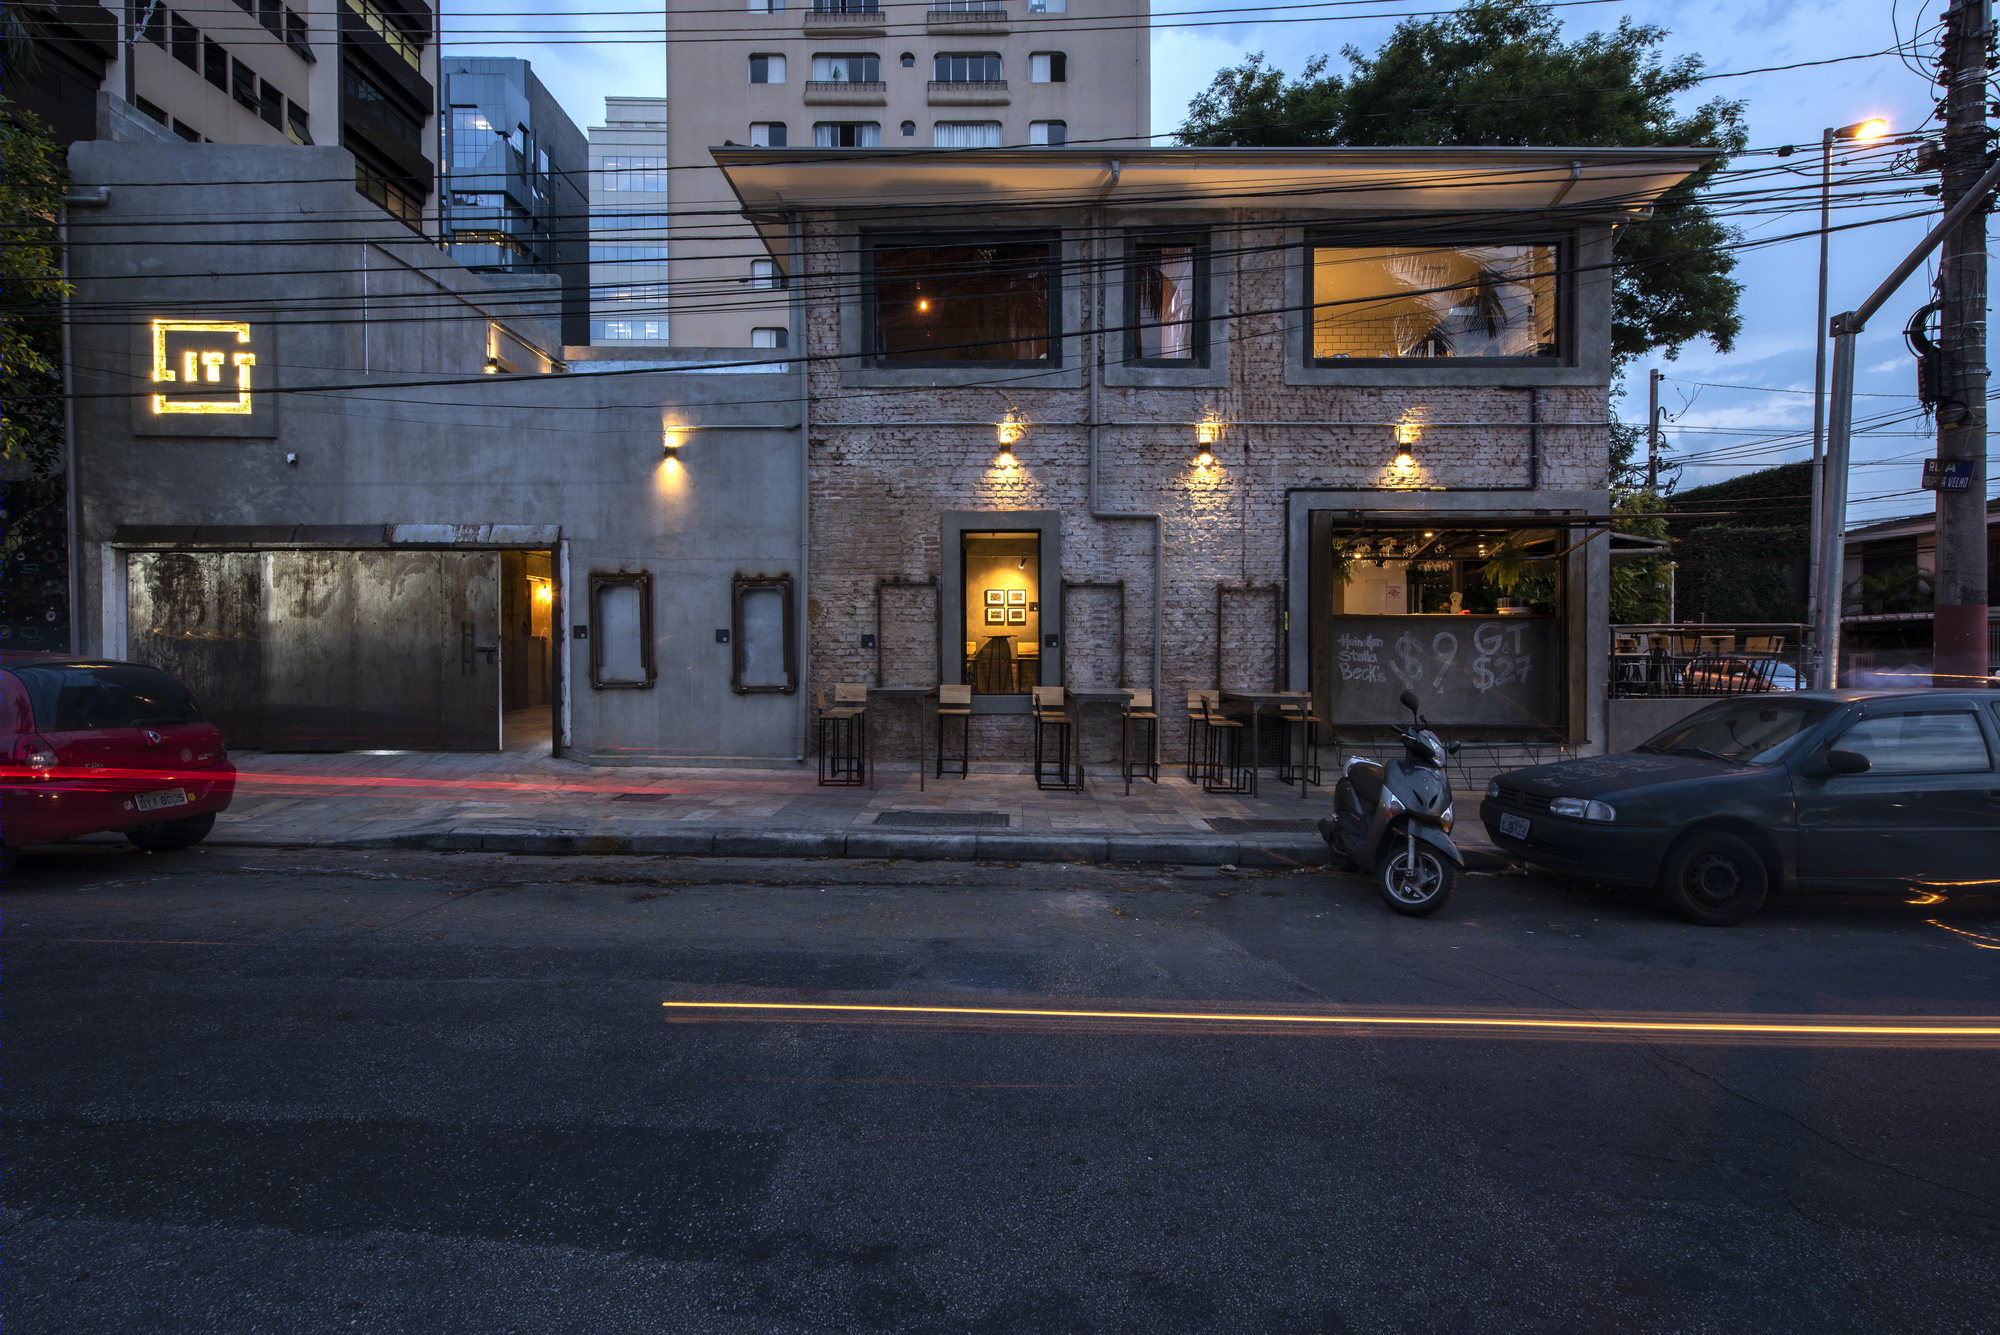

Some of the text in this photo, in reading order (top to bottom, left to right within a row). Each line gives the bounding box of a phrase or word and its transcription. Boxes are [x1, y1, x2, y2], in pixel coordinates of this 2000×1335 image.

[1929, 462, 1956, 472] RUA
[1338, 649, 1378, 664] Stella
[1338, 662, 1387, 683] Beck's
